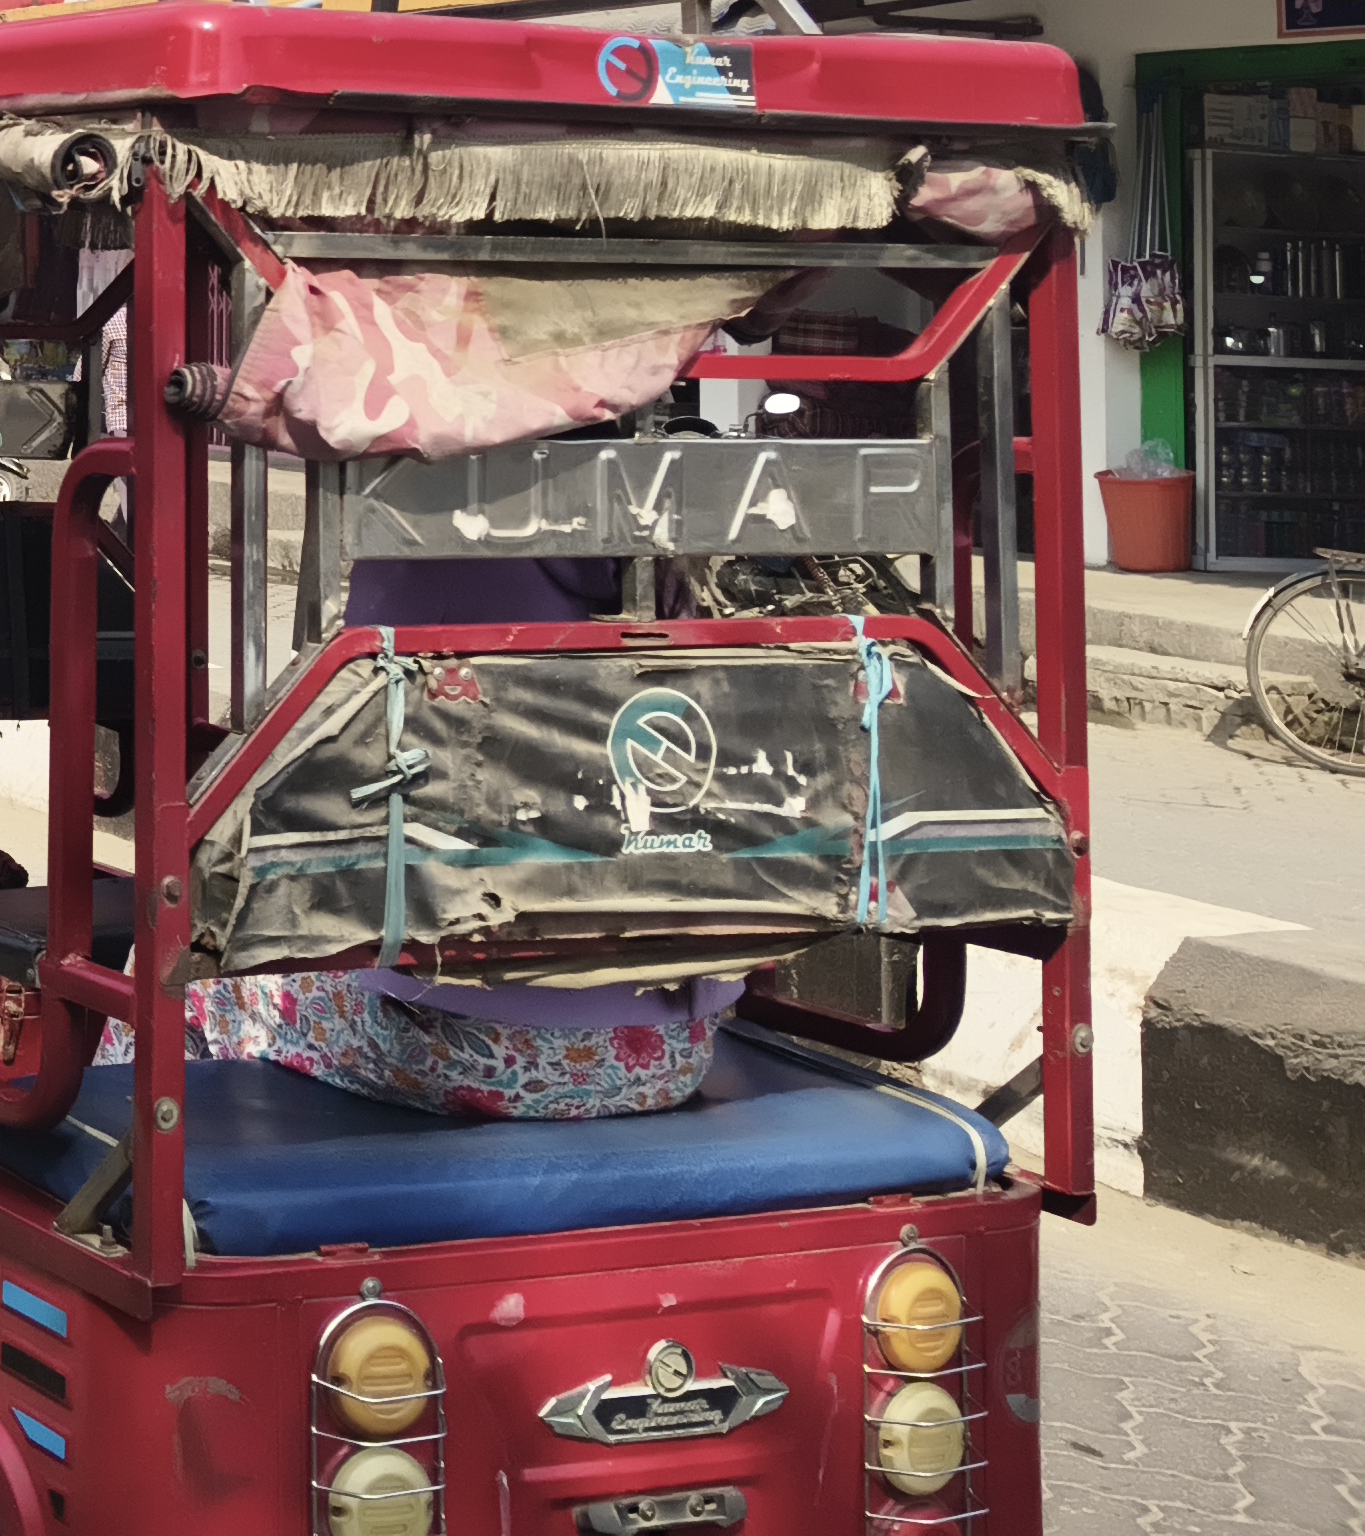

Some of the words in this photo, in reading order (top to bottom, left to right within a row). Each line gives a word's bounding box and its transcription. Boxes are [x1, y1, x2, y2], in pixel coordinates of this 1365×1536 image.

[684, 46, 732, 68] Kumar
[665, 66, 751, 92] Engineering
[355, 448, 924, 546] KUMAR
[621, 826, 713, 855] Kumar
